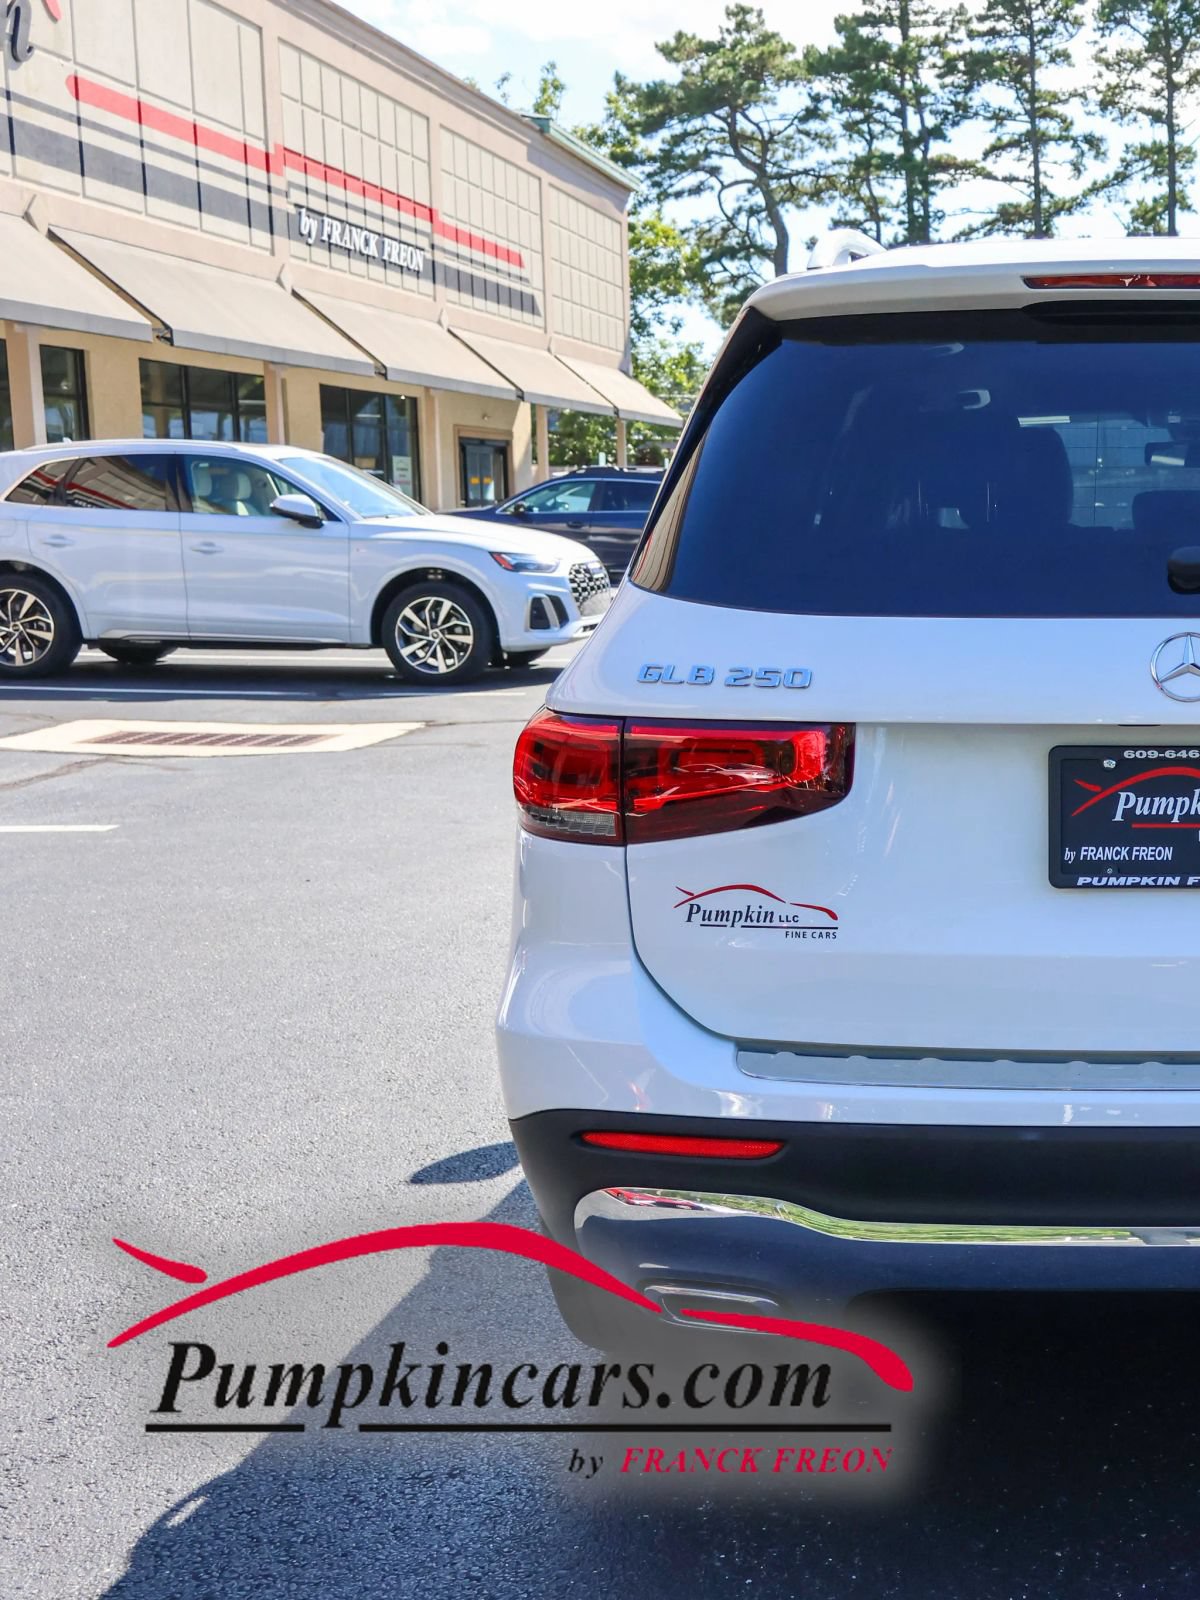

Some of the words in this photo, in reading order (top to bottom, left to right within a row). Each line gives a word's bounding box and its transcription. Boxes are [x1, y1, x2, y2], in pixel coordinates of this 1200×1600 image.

[299, 207, 317, 244] by
[321, 216, 379, 257] FRANCK
[381, 237, 424, 273] FREON
[637, 663, 715, 685] GLB
[723, 666, 813, 689] 250
[1064, 848, 1076, 863] by
[1080, 846, 1129, 861] FRANCK
[1131, 846, 1173, 861] FREON
[1076, 876, 1179, 886] PUMPKIN
[685, 903, 774, 928] Pumpkin
[778, 915, 799, 923] LLC
[785, 931, 807, 939] FINE
[811, 931, 837, 939] CARS
